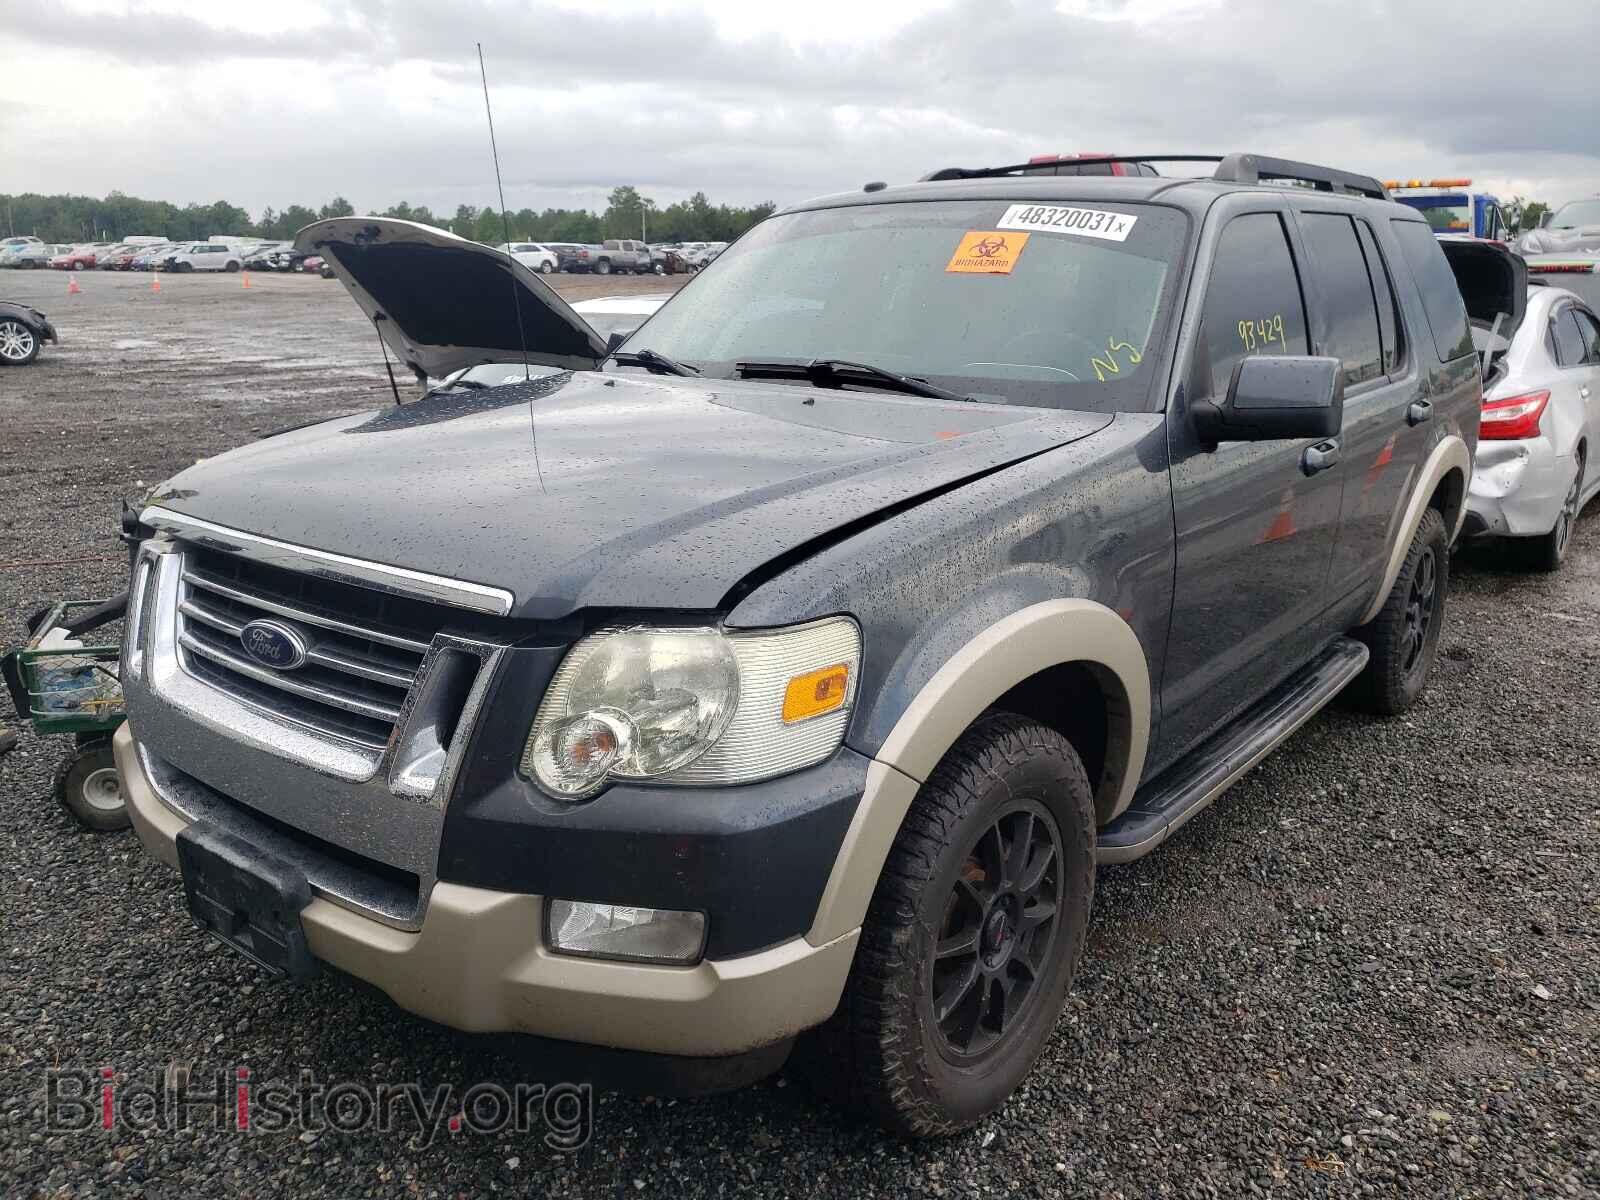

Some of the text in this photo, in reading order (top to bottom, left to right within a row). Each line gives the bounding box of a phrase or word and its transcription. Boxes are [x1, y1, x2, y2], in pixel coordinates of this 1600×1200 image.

[954, 257, 1009, 268] BIOHAZARD
[1238, 314, 1286, 353] 93429
[248, 628, 282, 660] Ford
